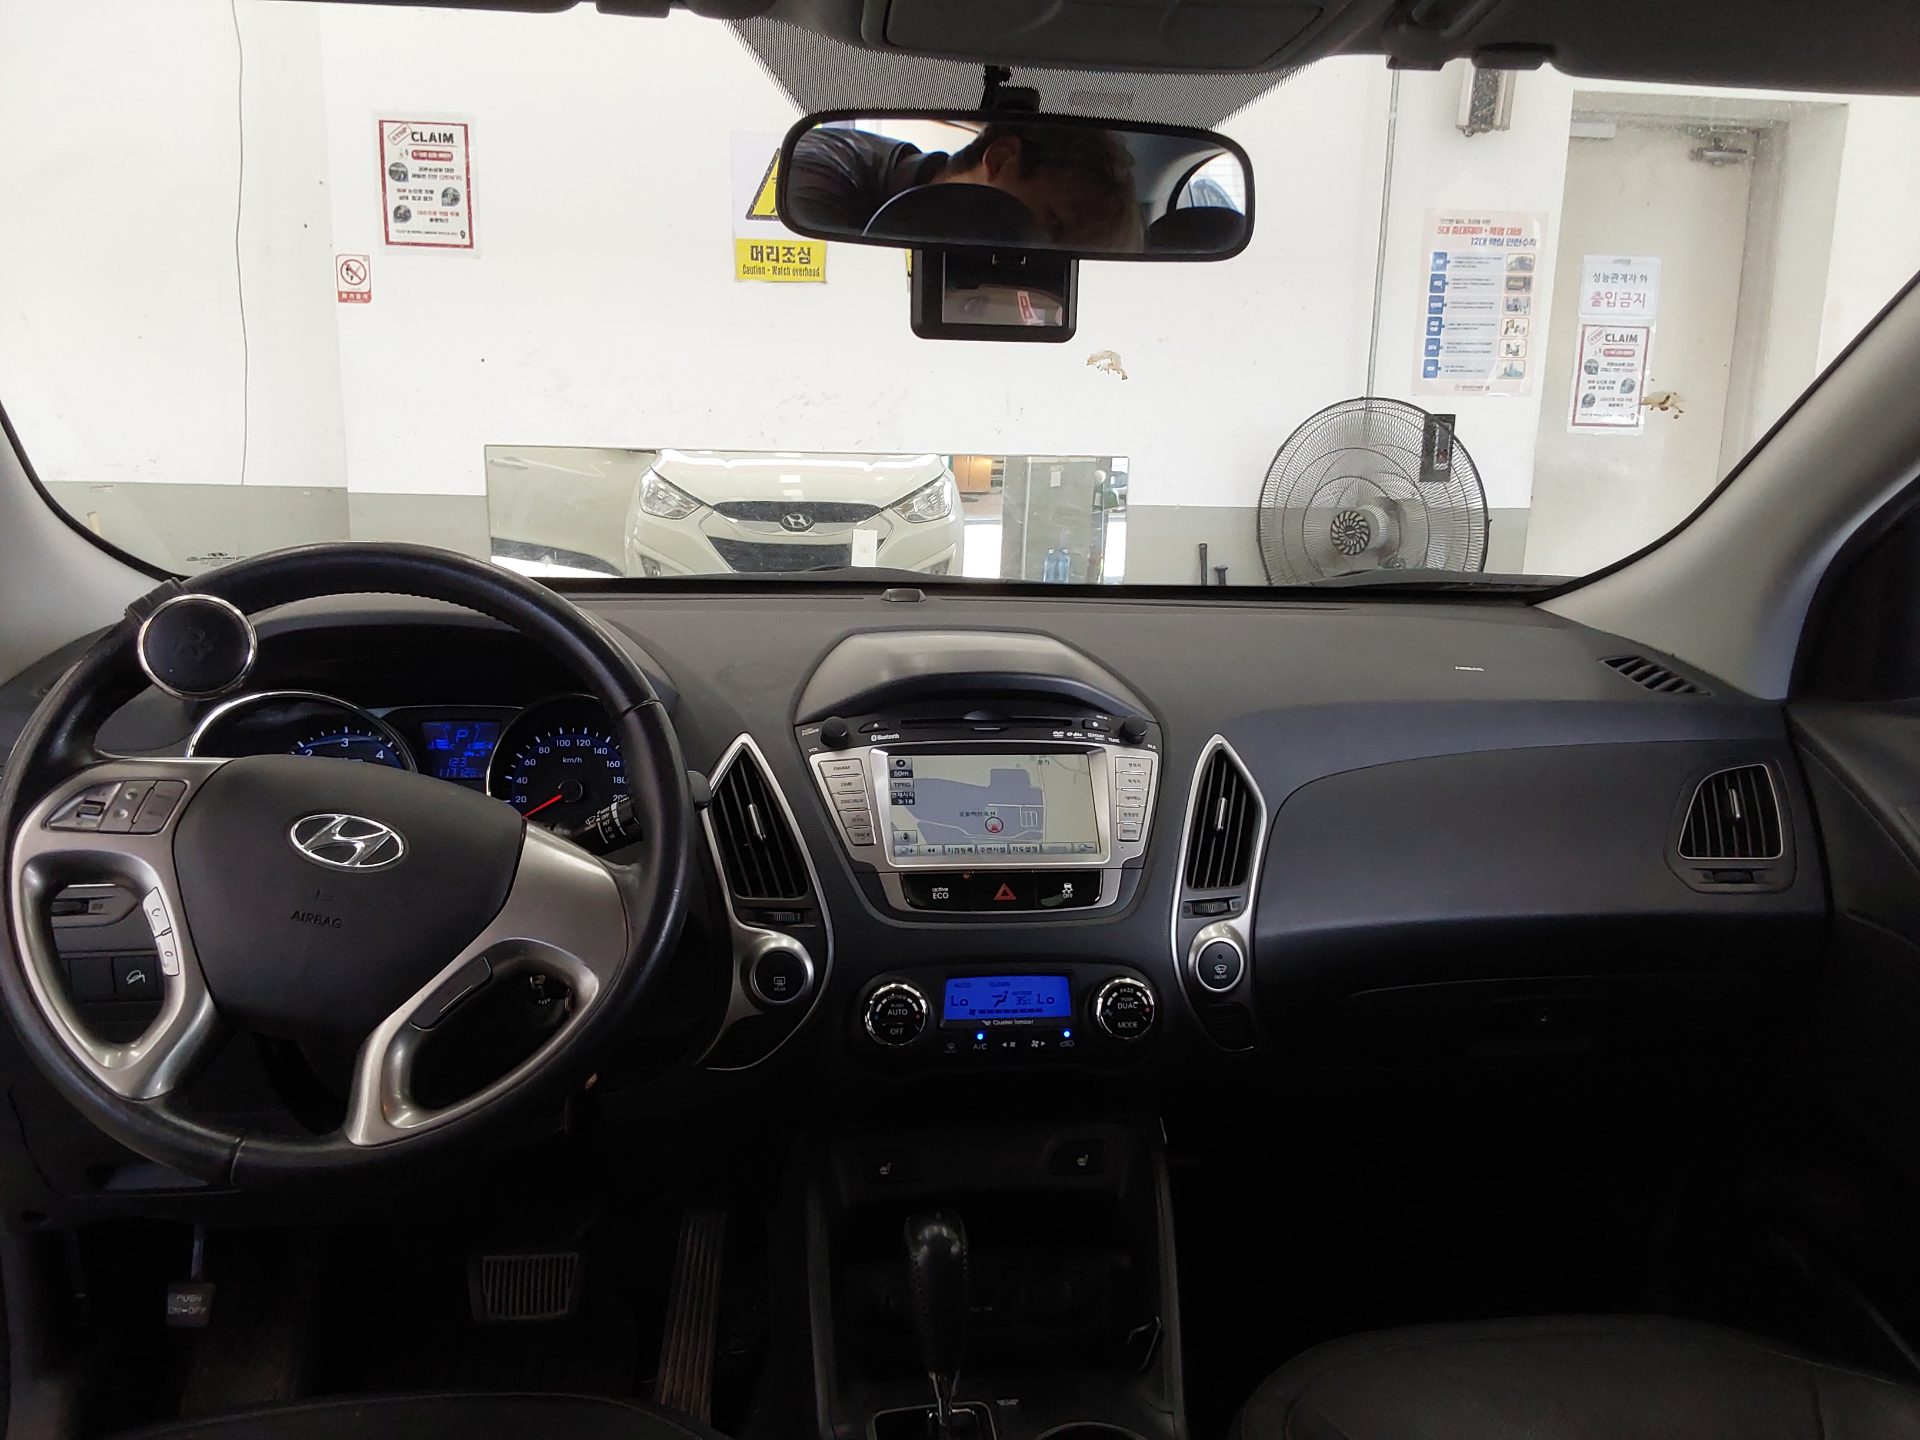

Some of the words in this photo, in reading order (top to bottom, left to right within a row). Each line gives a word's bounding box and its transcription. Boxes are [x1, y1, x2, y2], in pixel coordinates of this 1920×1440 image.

[411, 131, 454, 144] CLAIM
[750, 245, 811, 264] 머리조심
[742, 264, 766, 275] Caution
[772, 265, 791, 276] Watch
[792, 267, 820, 277] overhead
[1592, 272, 1637, 284] 성능관계자
[1591, 291, 1646, 309] 출입금지
[1605, 333, 1638, 343] CLAIM
[456, 729, 468, 743] P
[340, 738, 349, 747] 3
[556, 739, 571, 747] 100
[576, 739, 591, 747] 120
[376, 750, 384, 759] 4
[538, 746, 550, 754] 80
[594, 747, 608, 755] 140
[524, 758, 536, 766] 60
[562, 756, 582, 764] km/h
[606, 760, 620, 768] 160
[516, 777, 528, 785] 40
[932, 892, 949, 900] ECO
[290, 911, 342, 929] AIRBAG
[950, 995, 969, 1007] Lo
[1037, 993, 1055, 1005] Lo
[1117, 1021, 1138, 1029] MODE
